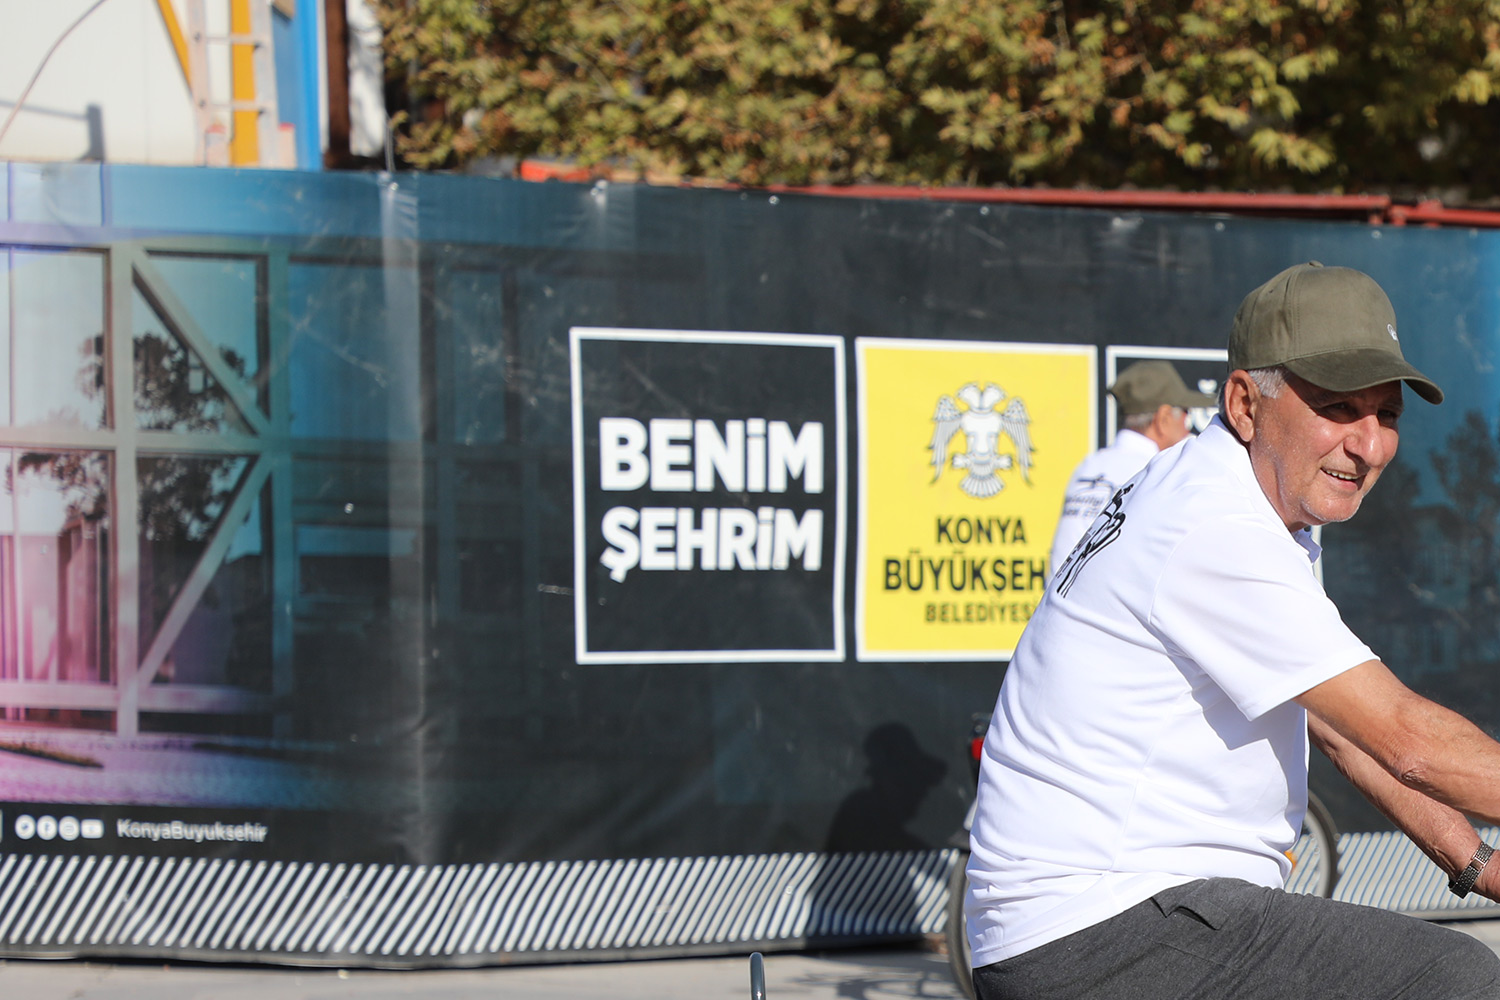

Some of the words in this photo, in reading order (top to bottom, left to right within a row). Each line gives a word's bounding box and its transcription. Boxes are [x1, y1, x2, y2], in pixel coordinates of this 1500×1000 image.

[600, 417, 824, 494] BENİM
[601, 506, 822, 583] ŞEHRİM
[936, 517, 1027, 544] KONYA
[884, 549, 1047, 597] BÜYÜKŞEH
[116, 818, 268, 843] KonyaBuyuksehir
